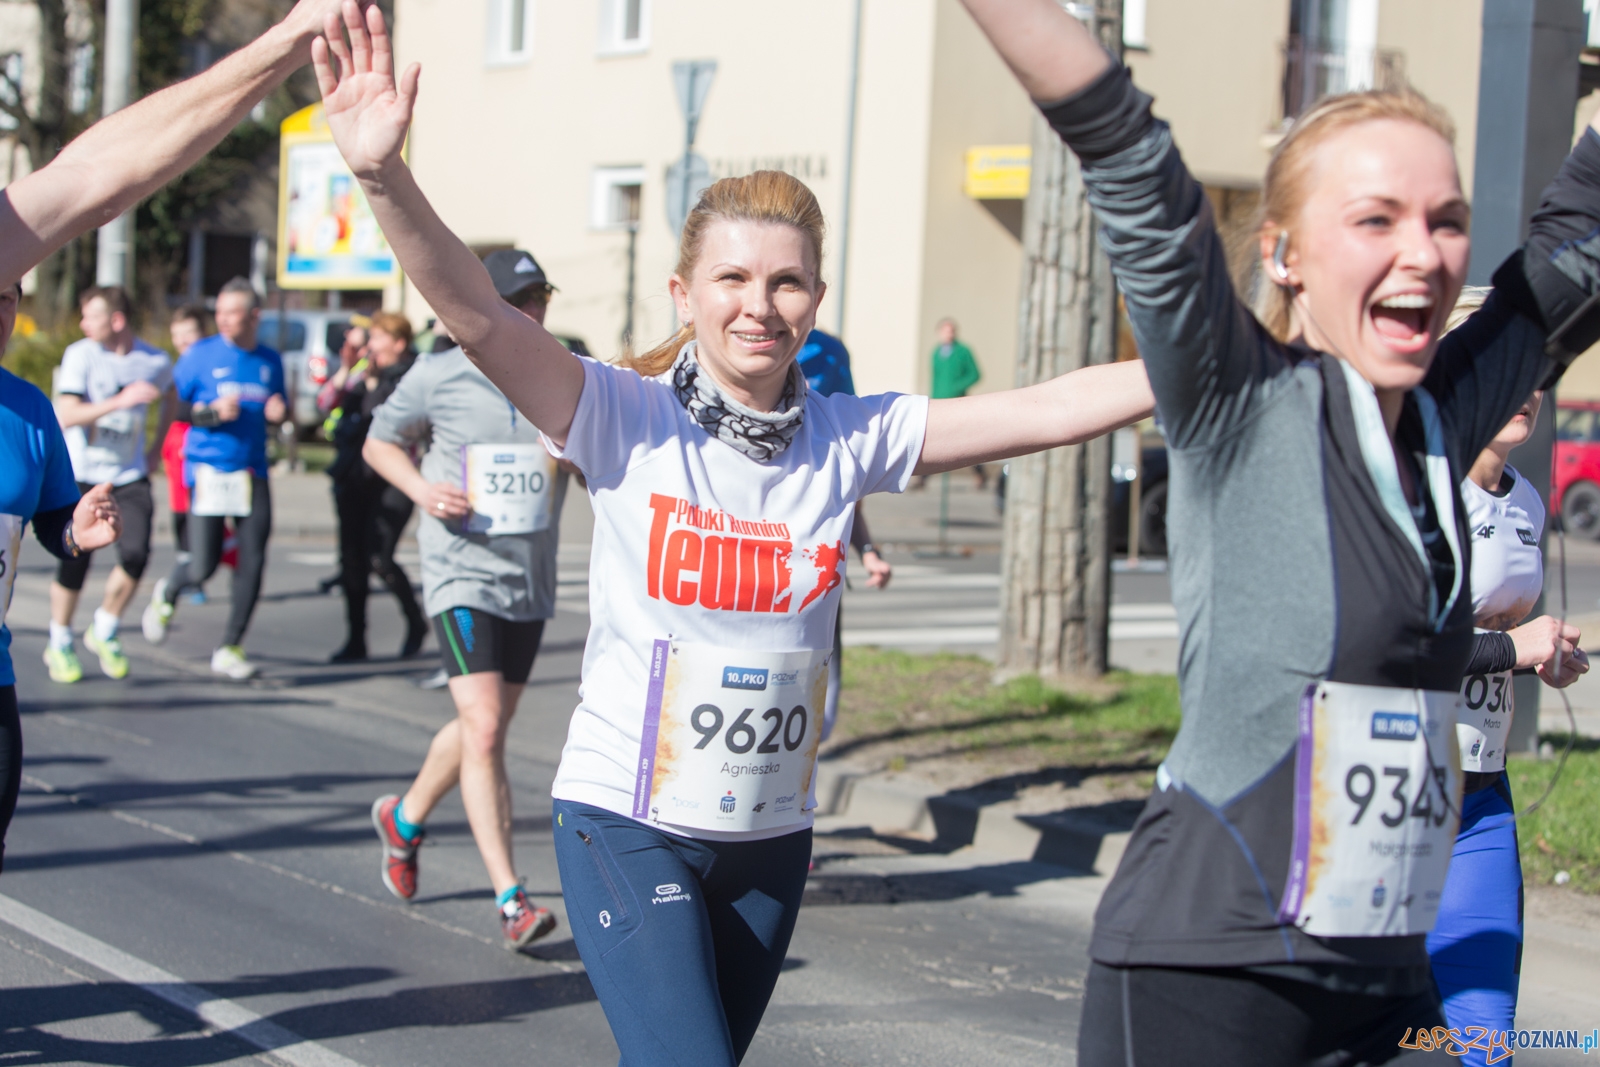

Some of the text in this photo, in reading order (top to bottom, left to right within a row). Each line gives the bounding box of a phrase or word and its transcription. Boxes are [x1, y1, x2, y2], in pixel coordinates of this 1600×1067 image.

[485, 472, 544, 494] 3210
[727, 514, 790, 540] Running
[1477, 525, 1495, 539] 4F
[647, 493, 793, 613] Team
[742, 674, 765, 685] PKO
[691, 703, 807, 754] 9620
[1483, 718, 1501, 728] Marta
[720, 762, 780, 777] Agnieszka
